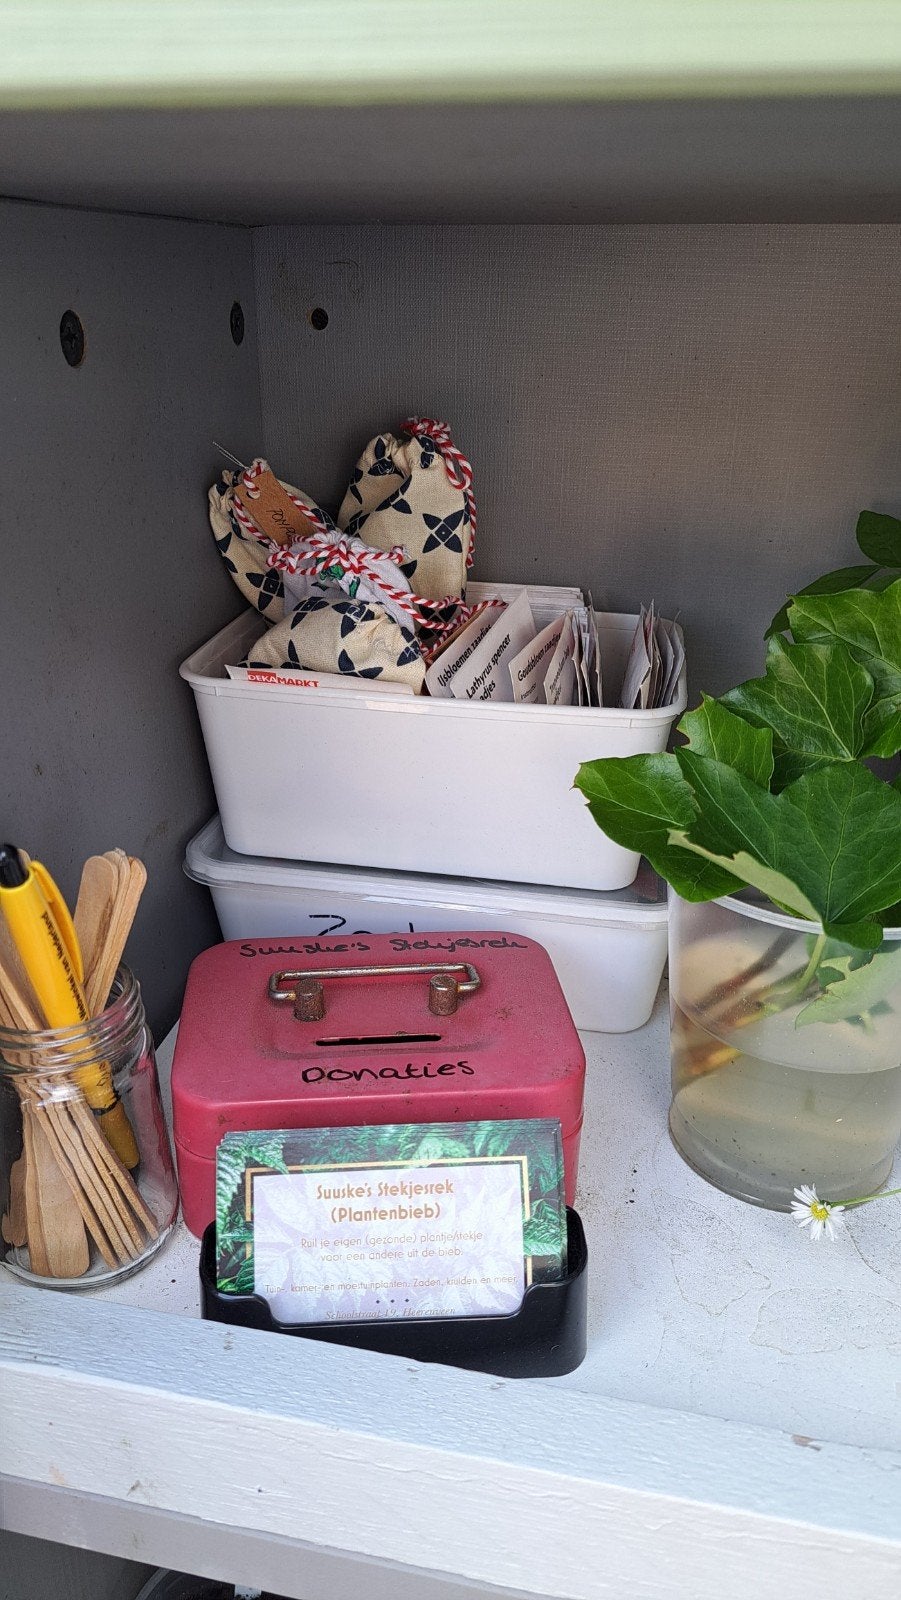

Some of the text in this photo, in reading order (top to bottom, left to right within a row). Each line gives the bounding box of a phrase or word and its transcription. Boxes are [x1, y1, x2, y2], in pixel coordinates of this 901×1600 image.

[437, 646, 473, 687] IJsbloemen
[466, 634, 511, 699] Lathyrus spencer
[247, 672, 319, 688] DEKAMARKT
[41, 911, 65, 960] Nederland
[239, 942, 371, 957] Suuske's
[62, 957, 72, 975] van
[301, 1061, 475, 1083] Donaties
[316, 1179, 454, 1200] Suuske's Stekjesrek
[331, 1202, 441, 1223] (Plantenbieb)
[301, 1230, 483, 1249] Ruil je eigen (gezonde) plantje/stekje
[320, 1254, 342, 1263] voor
[346, 1252, 365, 1261] een
[368, 1250, 404, 1261] andere
[407, 1249, 419, 1259] uit
[421, 1248, 435, 1258] de
[290, 1283, 321, 1293] kamer-
[446, 1276, 477, 1286] kruiden
[480, 1276, 491, 1284] en
[325, 1309, 381, 1320] Schoolstraat
[403, 1307, 456, 1317] Heerenveen
